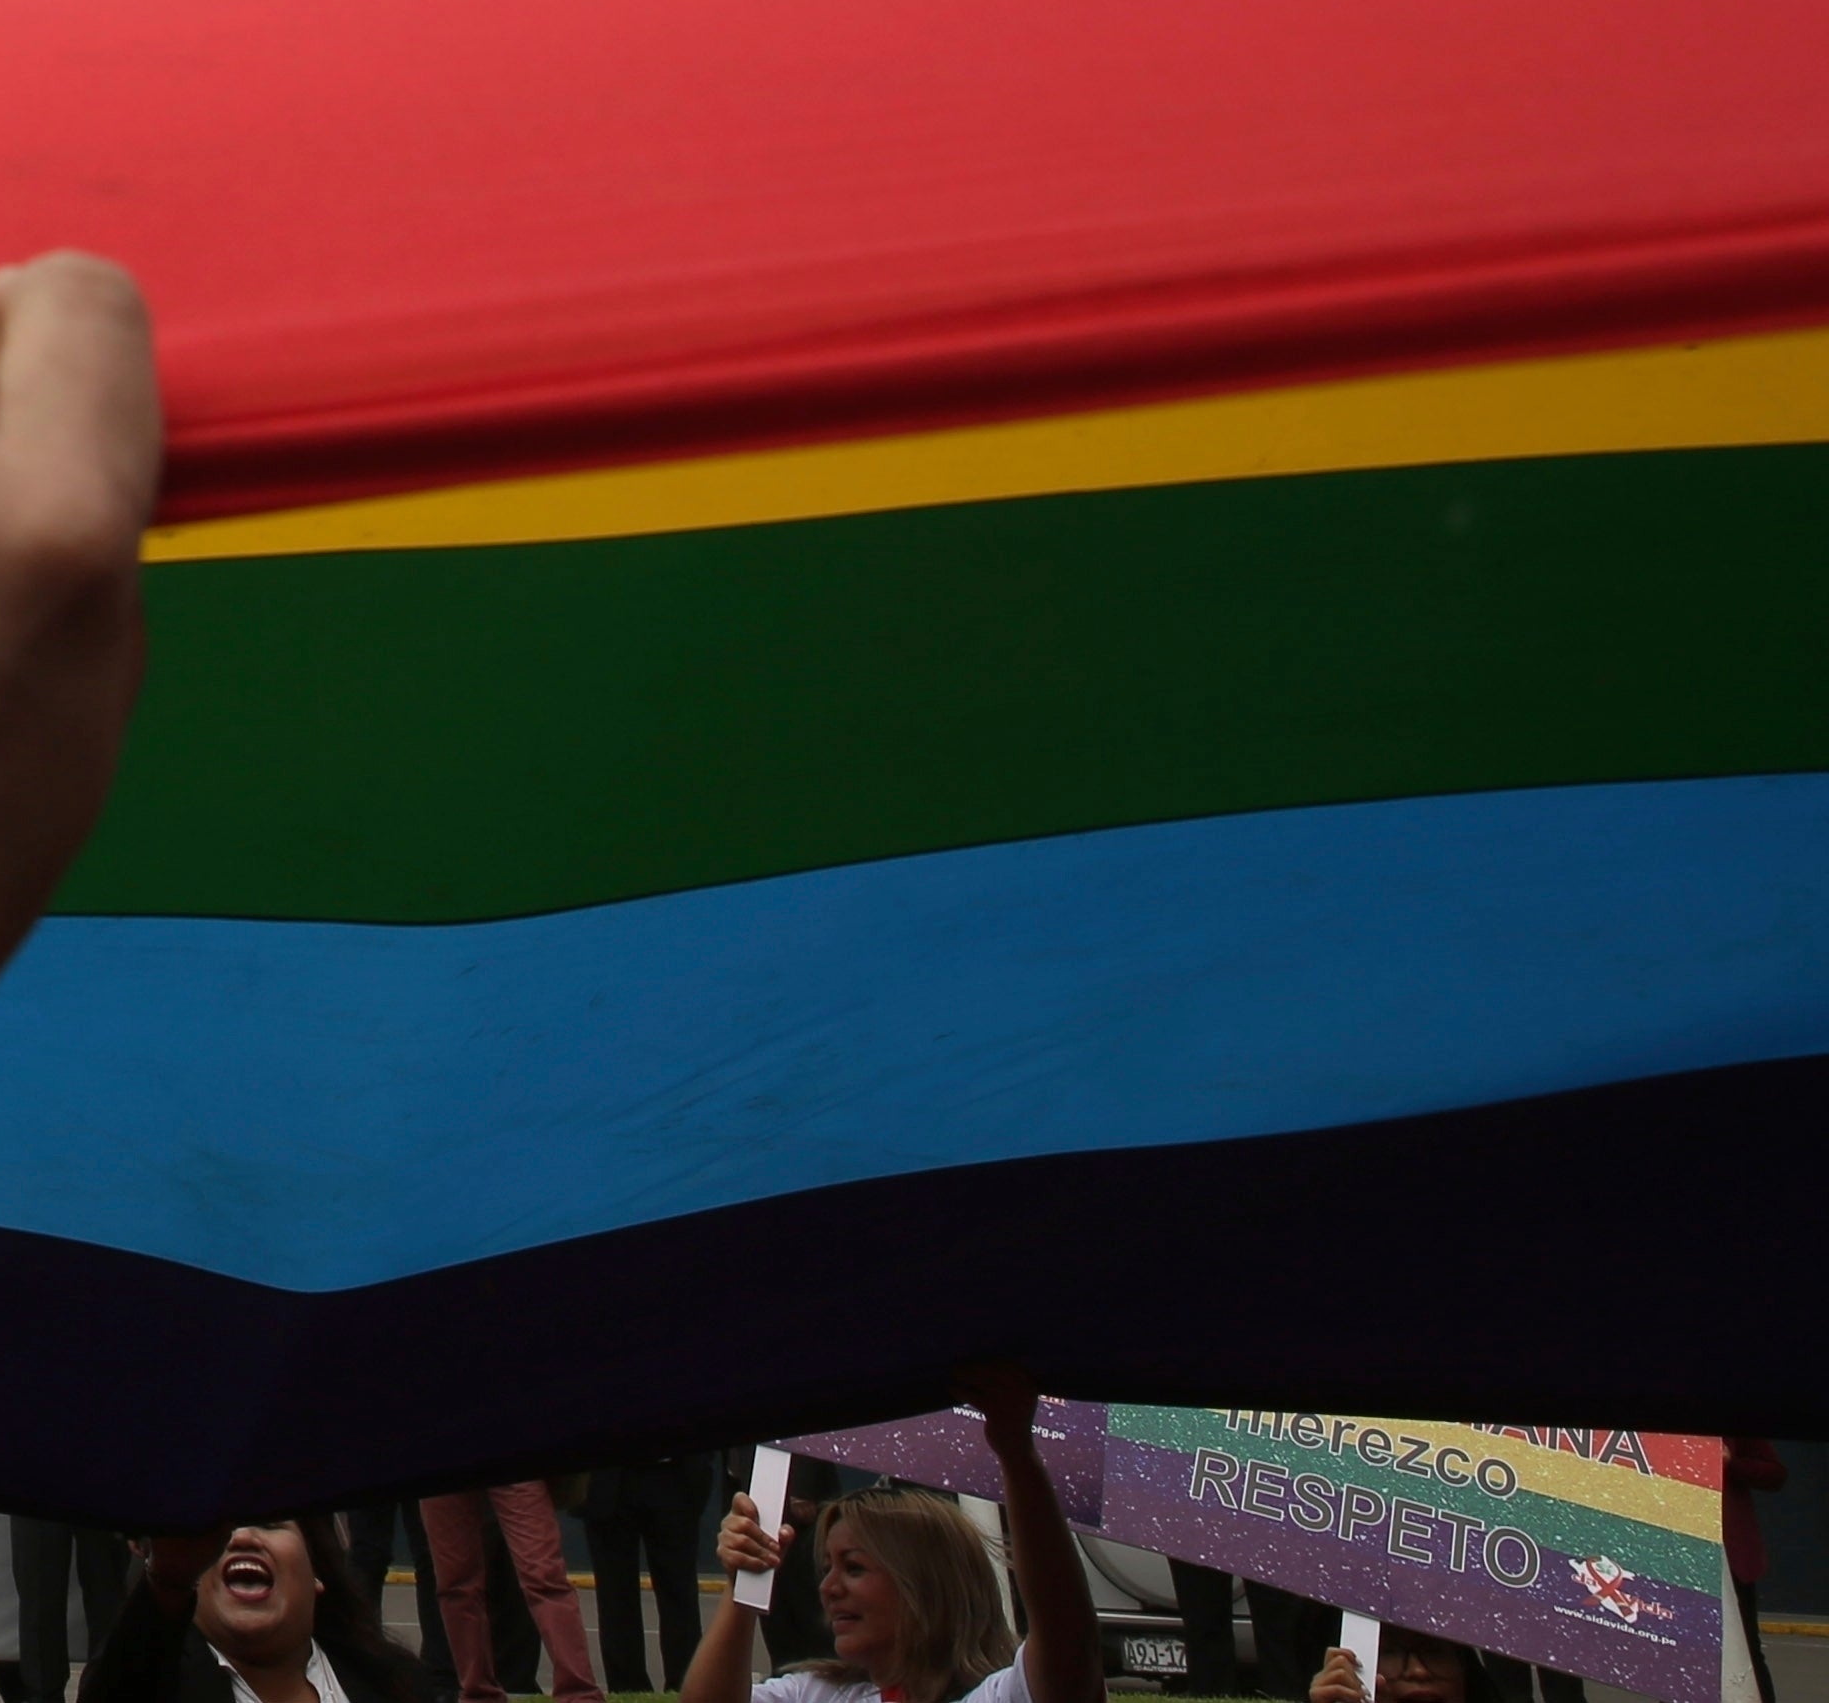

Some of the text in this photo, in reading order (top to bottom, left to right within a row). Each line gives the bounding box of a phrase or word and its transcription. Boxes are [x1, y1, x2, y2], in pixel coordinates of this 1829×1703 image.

[1225, 1411, 1518, 1499] merezco
[1190, 1447, 1541, 1589] RESPETO
[1553, 1605, 1677, 1647] www.sidavida.org.pe
